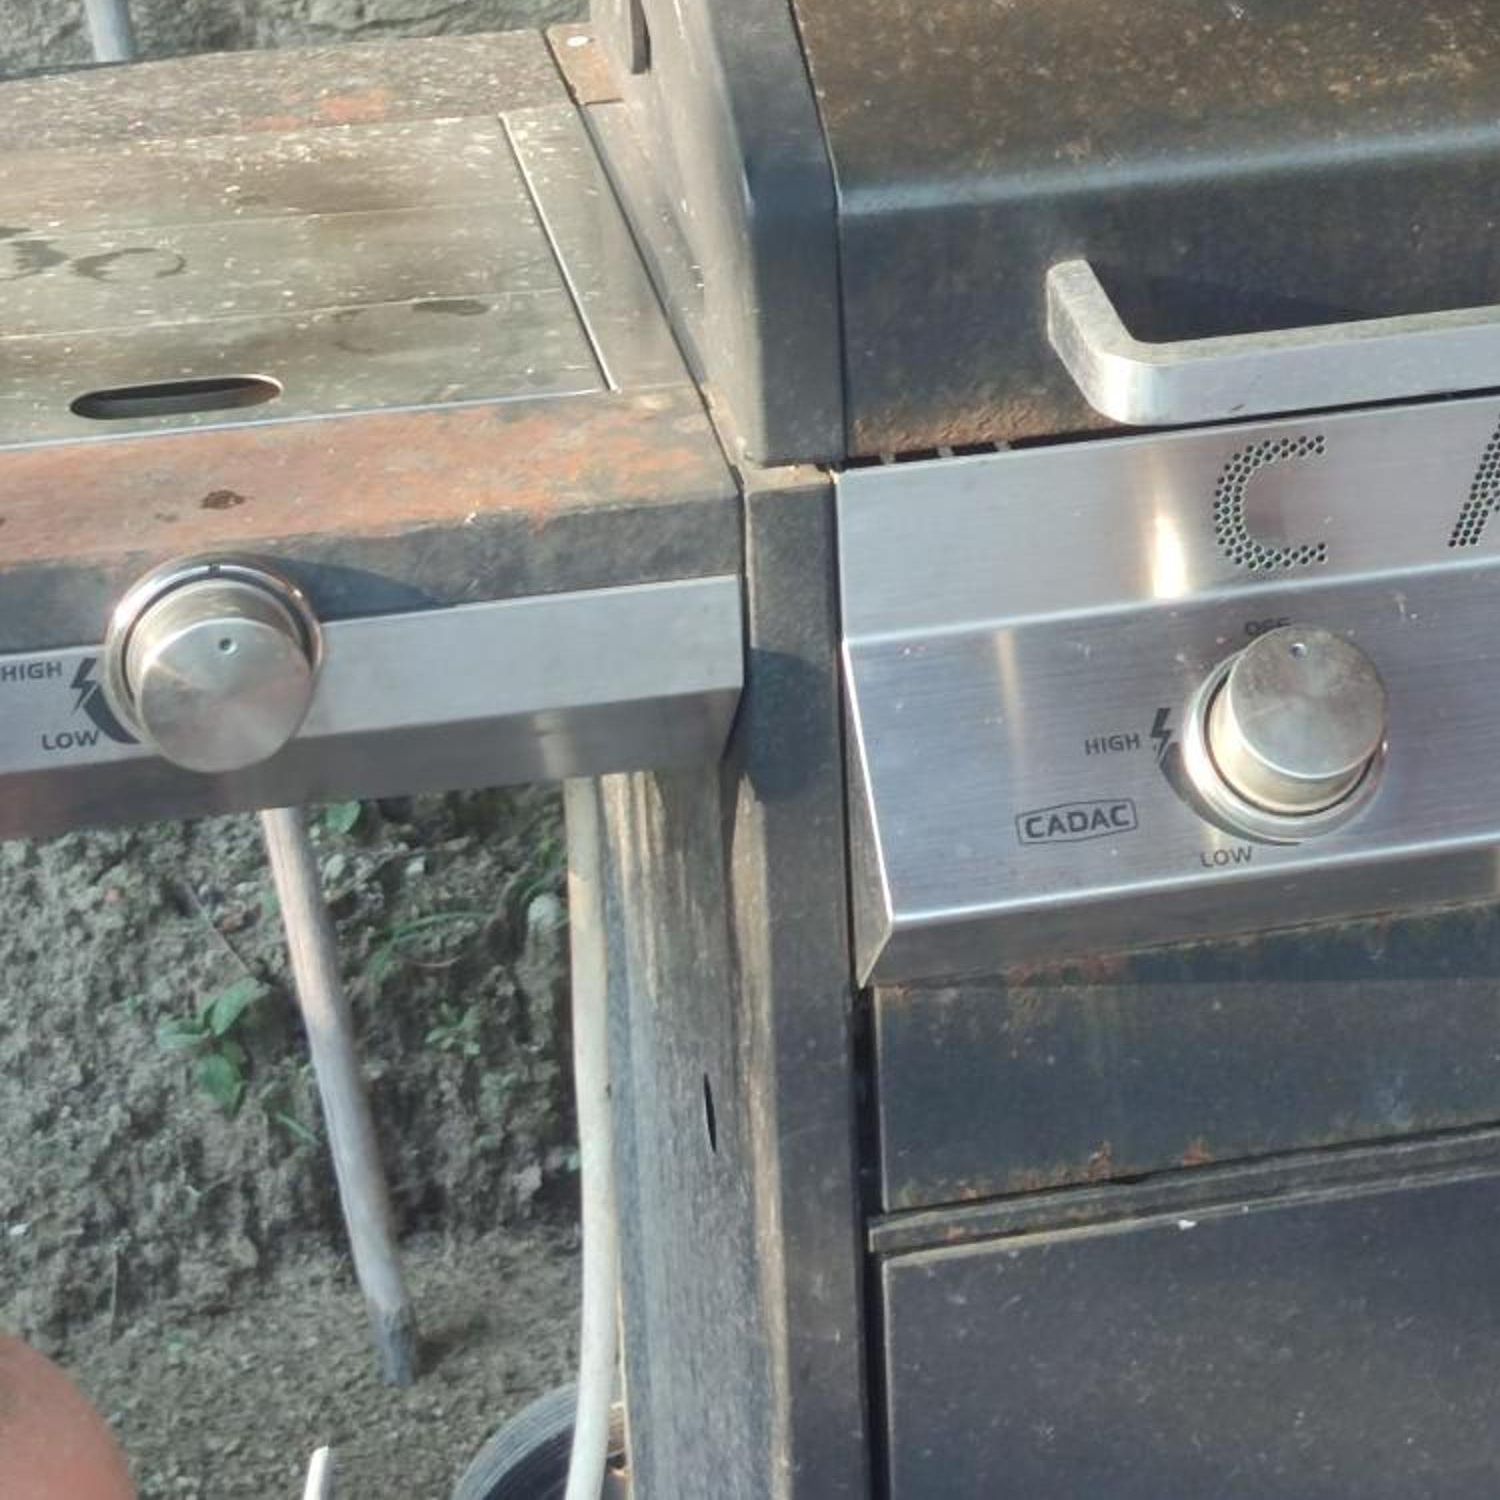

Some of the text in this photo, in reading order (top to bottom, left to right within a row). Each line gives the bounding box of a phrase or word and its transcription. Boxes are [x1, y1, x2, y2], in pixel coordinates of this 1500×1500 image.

[1, 661, 62, 682] HIGH
[42, 729, 99, 751] LOW
[1084, 733, 1141, 756] HIGH
[1024, 803, 1131, 839] CADAC
[1200, 846, 1253, 868] LOW
